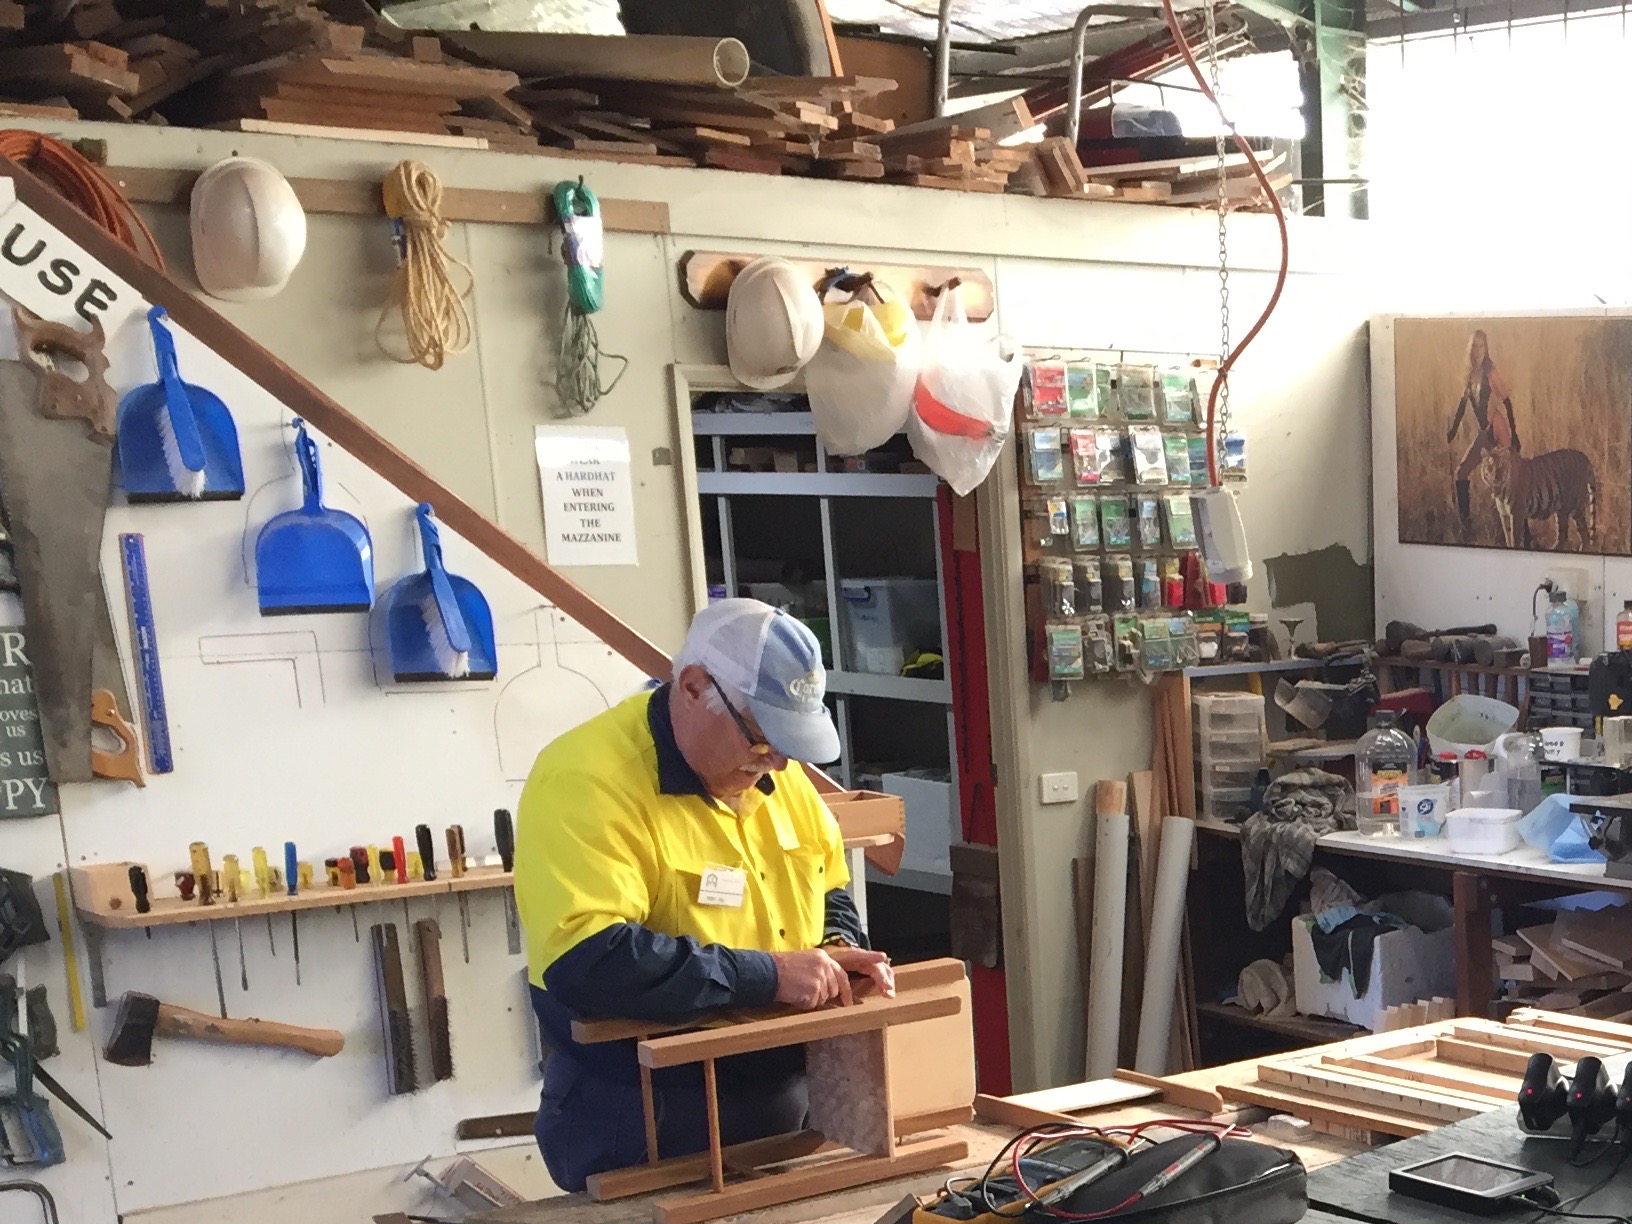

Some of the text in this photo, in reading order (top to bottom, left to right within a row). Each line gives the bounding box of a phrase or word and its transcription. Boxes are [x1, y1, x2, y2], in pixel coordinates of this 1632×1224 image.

[1, 223, 118, 323] USE
[555, 471, 616, 482] A HARDHAT
[571, 488, 604, 497] WHEN
[563, 502, 615, 512] ENTERING
[579, 518, 601, 528] THE
[561, 533, 622, 543] MAZZANINE
[1, 632, 32, 667] R
[6, 725, 26, 738] us
[17, 751, 45, 767] us
[0, 775, 48, 811] PY
